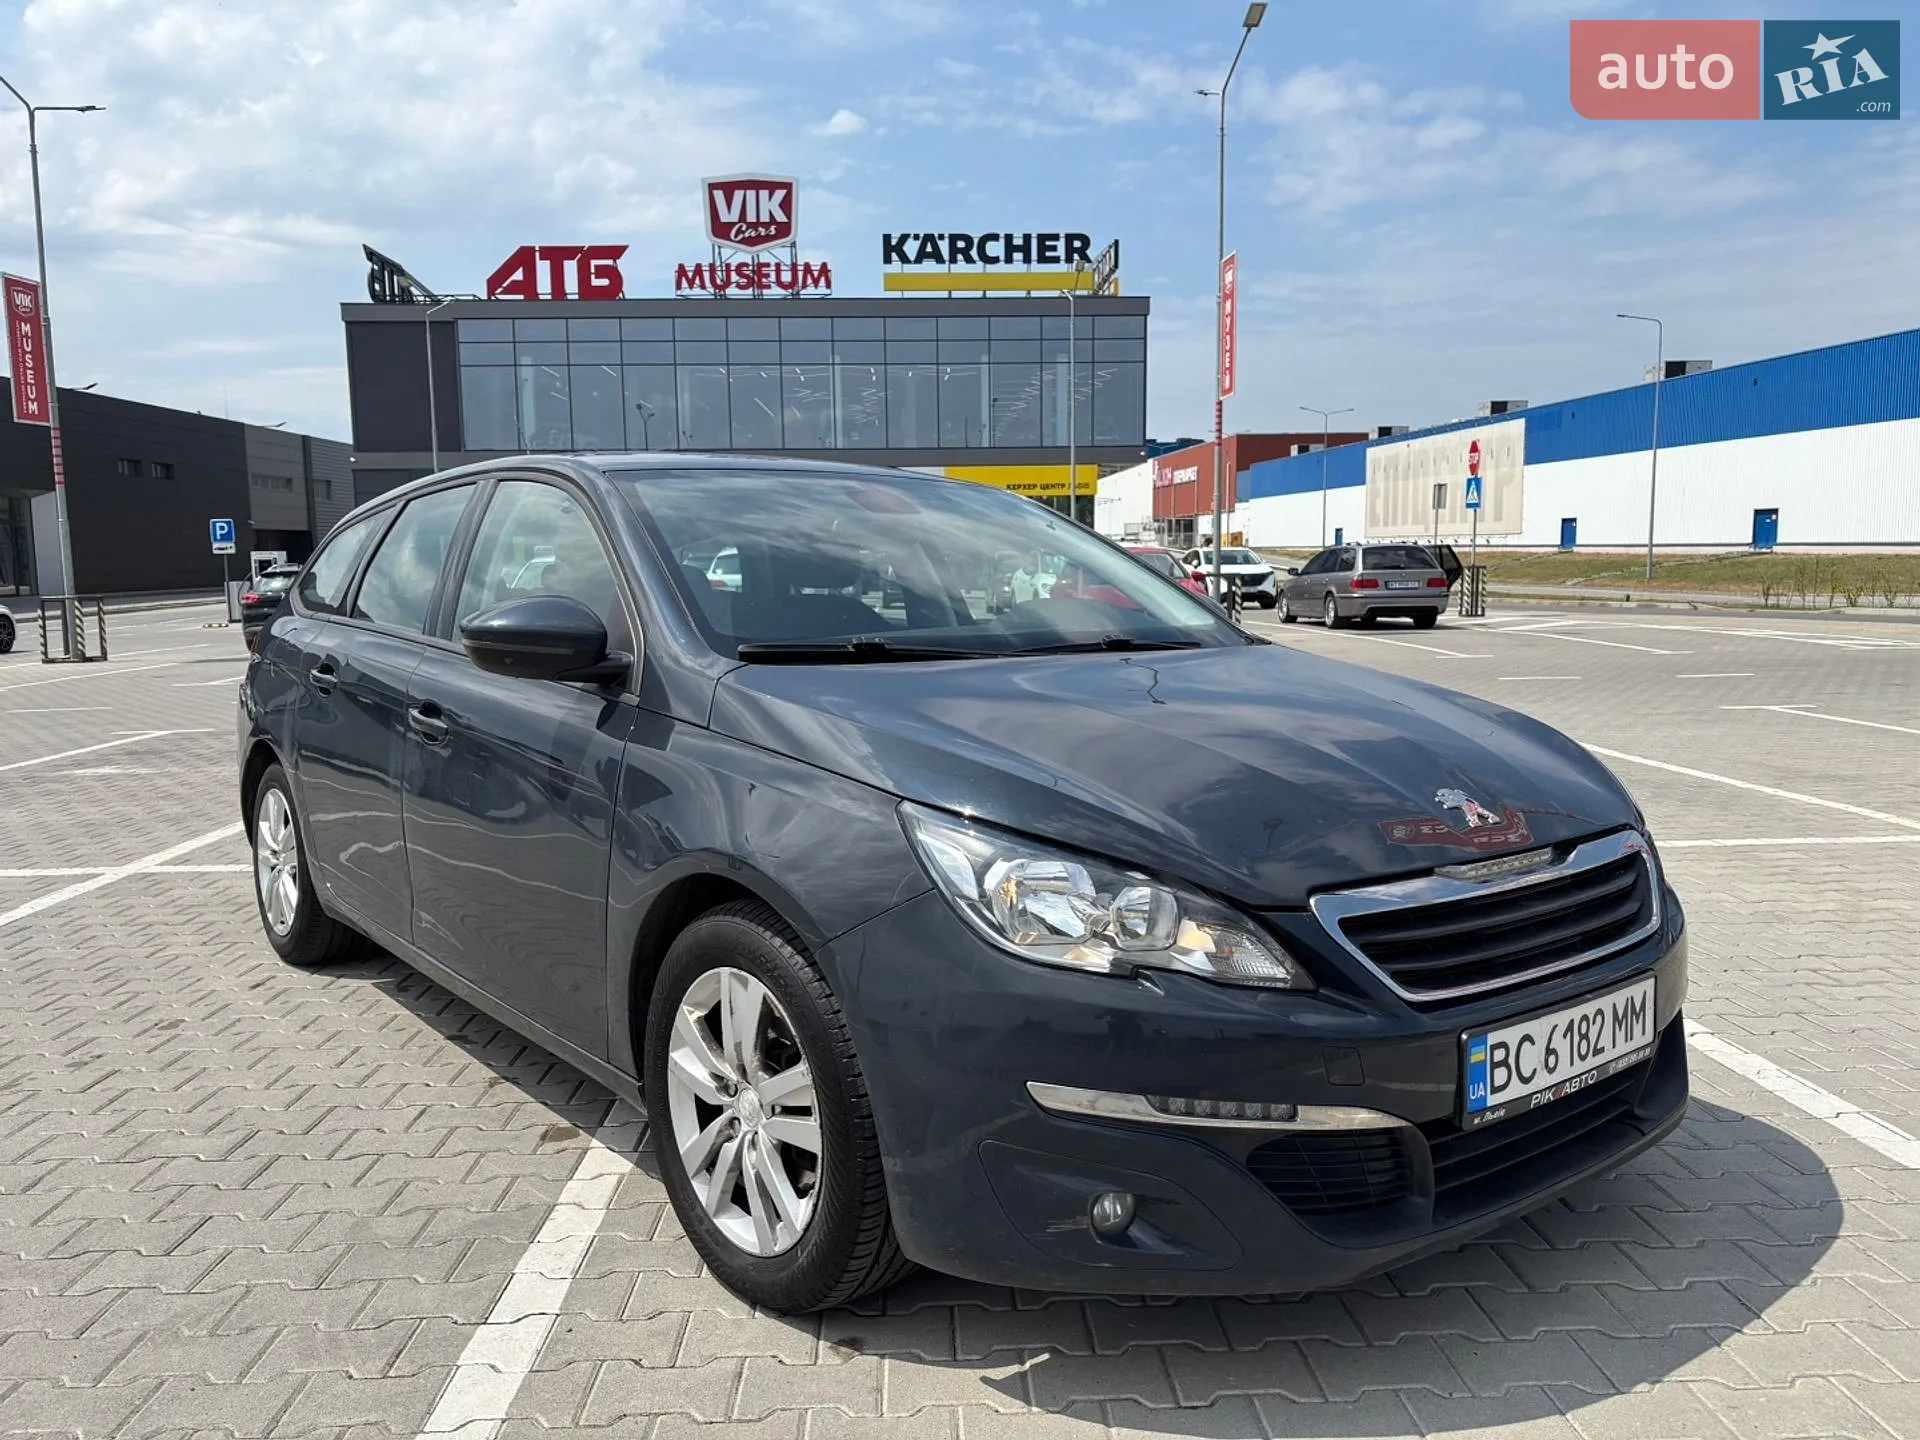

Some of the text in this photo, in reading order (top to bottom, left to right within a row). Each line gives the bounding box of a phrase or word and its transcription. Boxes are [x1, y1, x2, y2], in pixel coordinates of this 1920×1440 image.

[712, 189, 789, 223] VIK
[730, 222, 777, 241] Cars
[882, 232, 1094, 265] KÄRCHER
[675, 261, 833, 292] MUSEUM
[13, 291, 33, 308] VIK
[21, 321, 39, 415] MUSEUM
[1040, 482, 1066, 492] ЦЕНТР
[215, 522, 229, 540] P
[1489, 1032, 1538, 1096] BC
[1543, 1007, 1606, 1076] 6182
[1611, 989, 1648, 1049] MM
[1469, 1081, 1486, 1100] UA
[1561, 1070, 1597, 1097] АВТО
